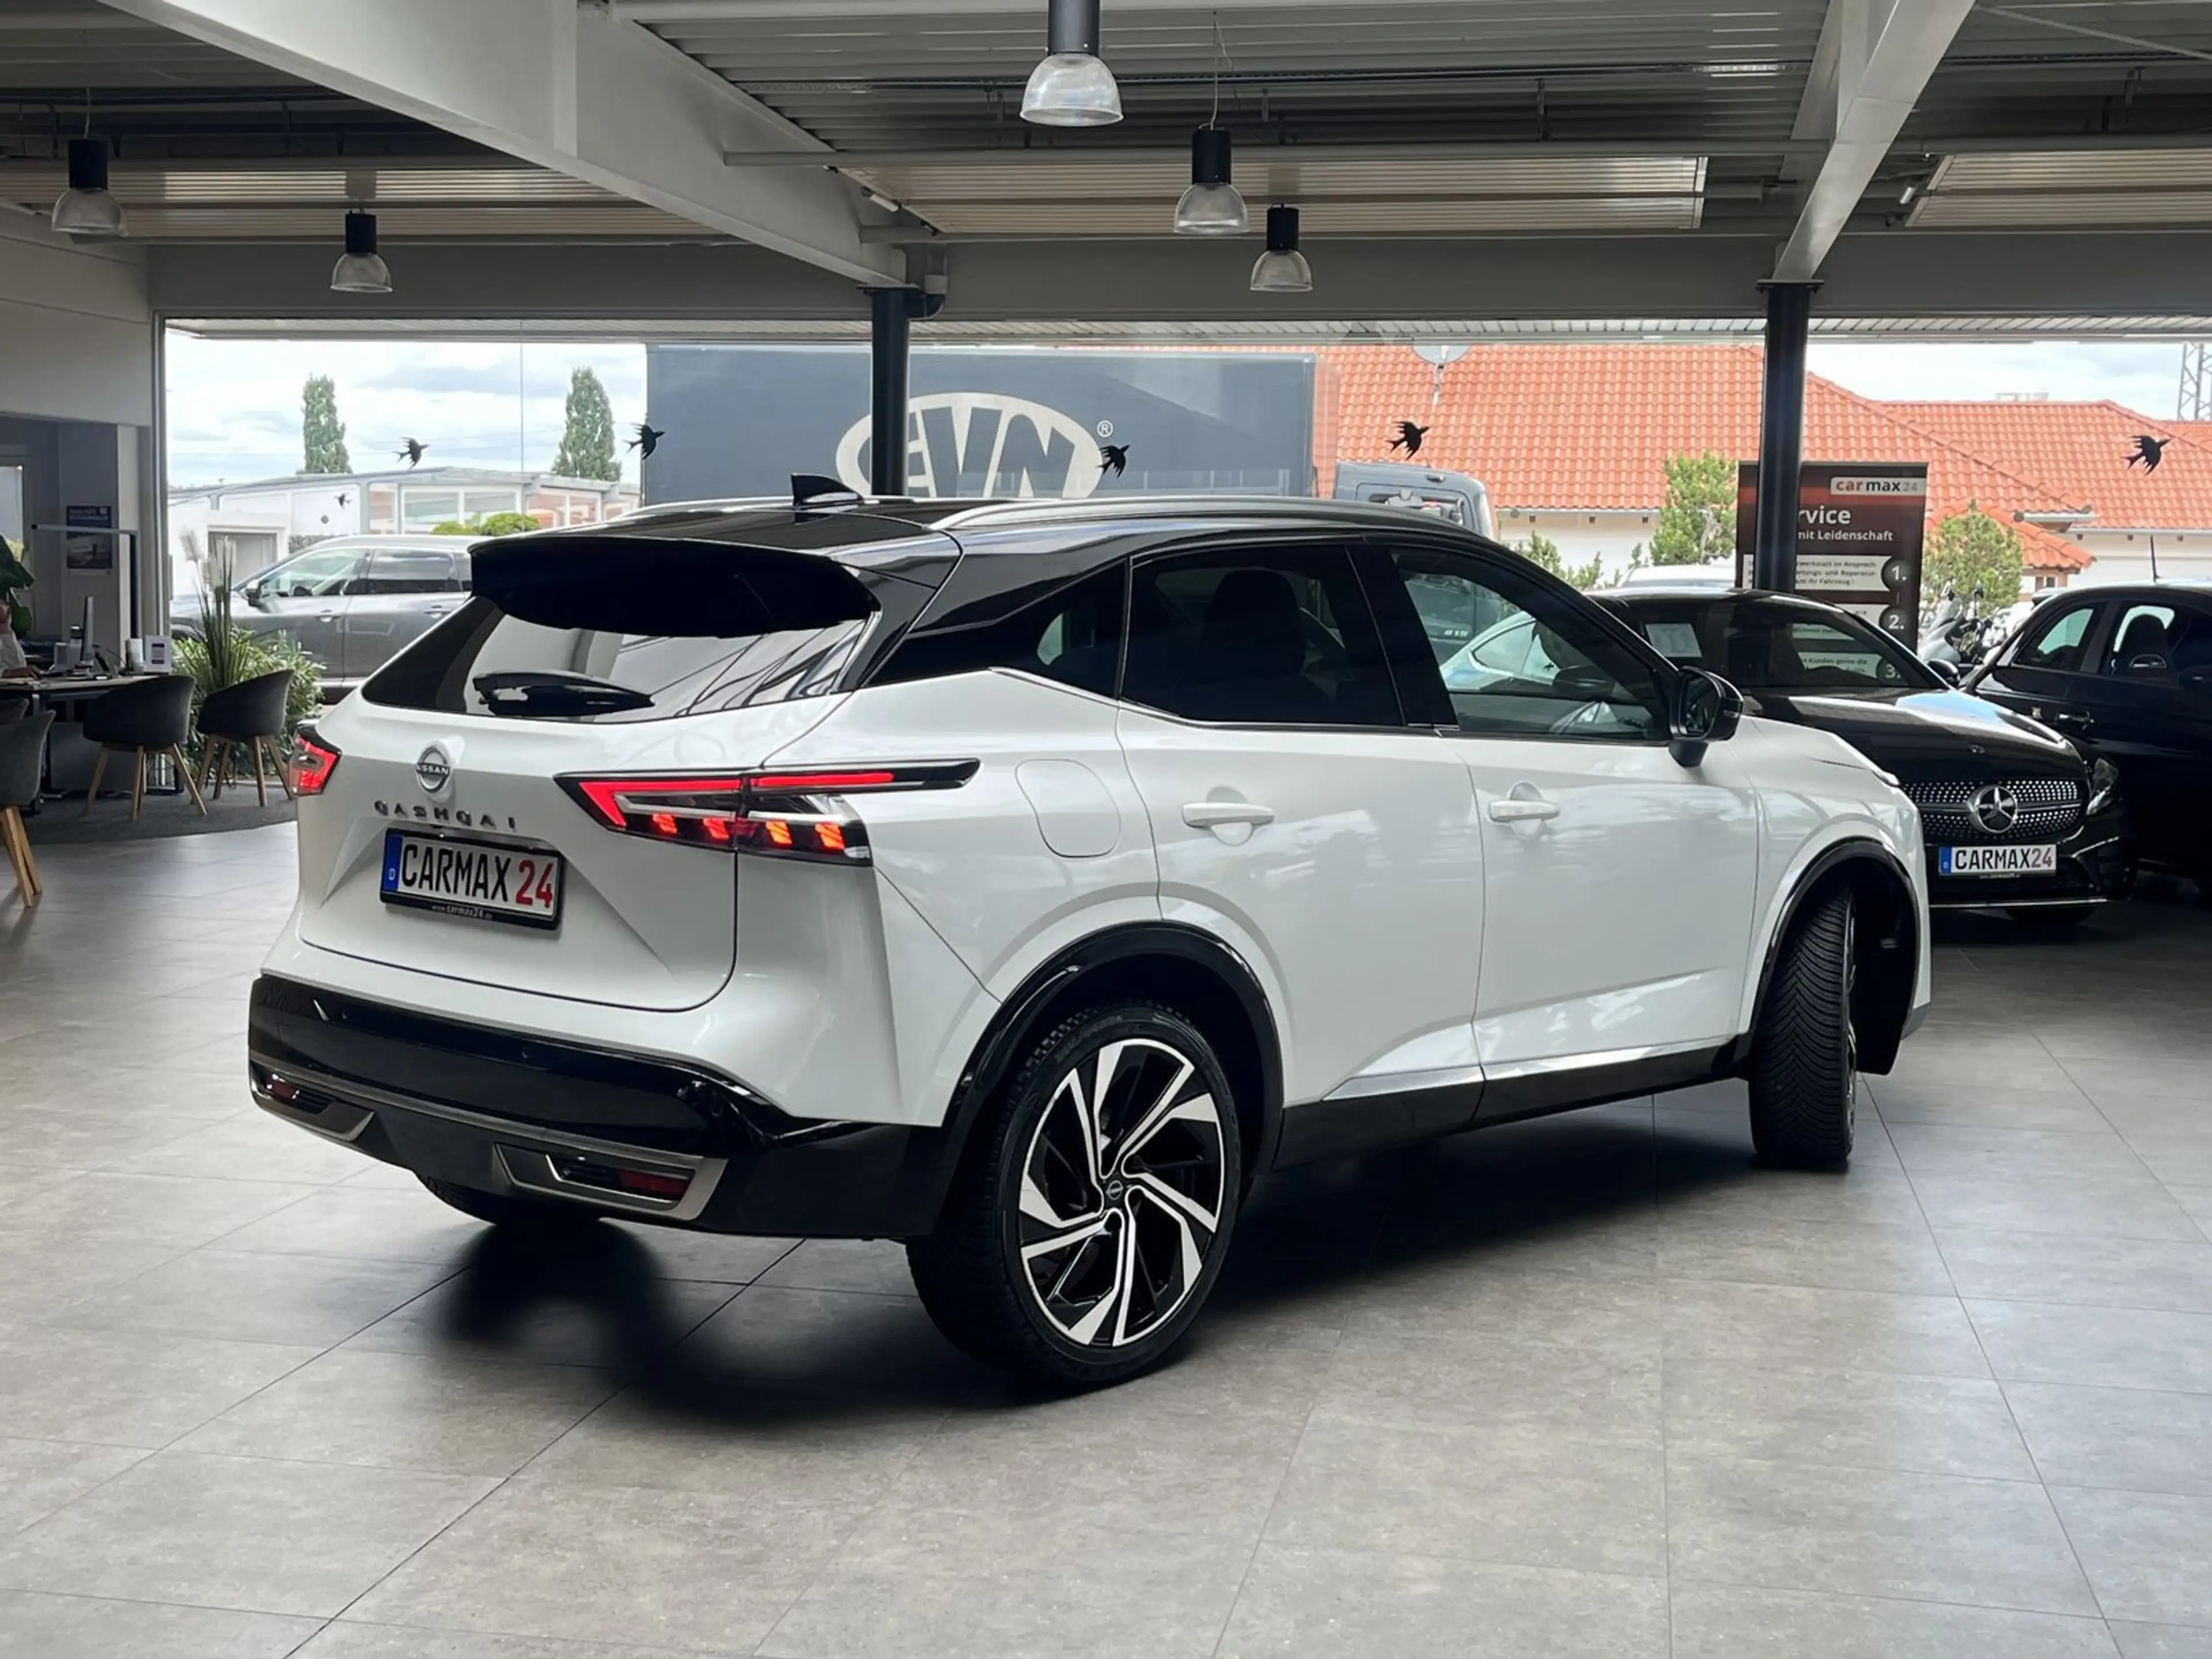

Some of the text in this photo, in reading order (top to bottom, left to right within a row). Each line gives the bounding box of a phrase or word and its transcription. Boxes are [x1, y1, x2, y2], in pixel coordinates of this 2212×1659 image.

[1798, 504, 1851, 525] rvice
[1817, 529, 1894, 541] Leidenschaft
[1891, 565, 1907, 581] 1.
[1888, 613, 1905, 630] 2.
[374, 800, 517, 830] QASHQAI
